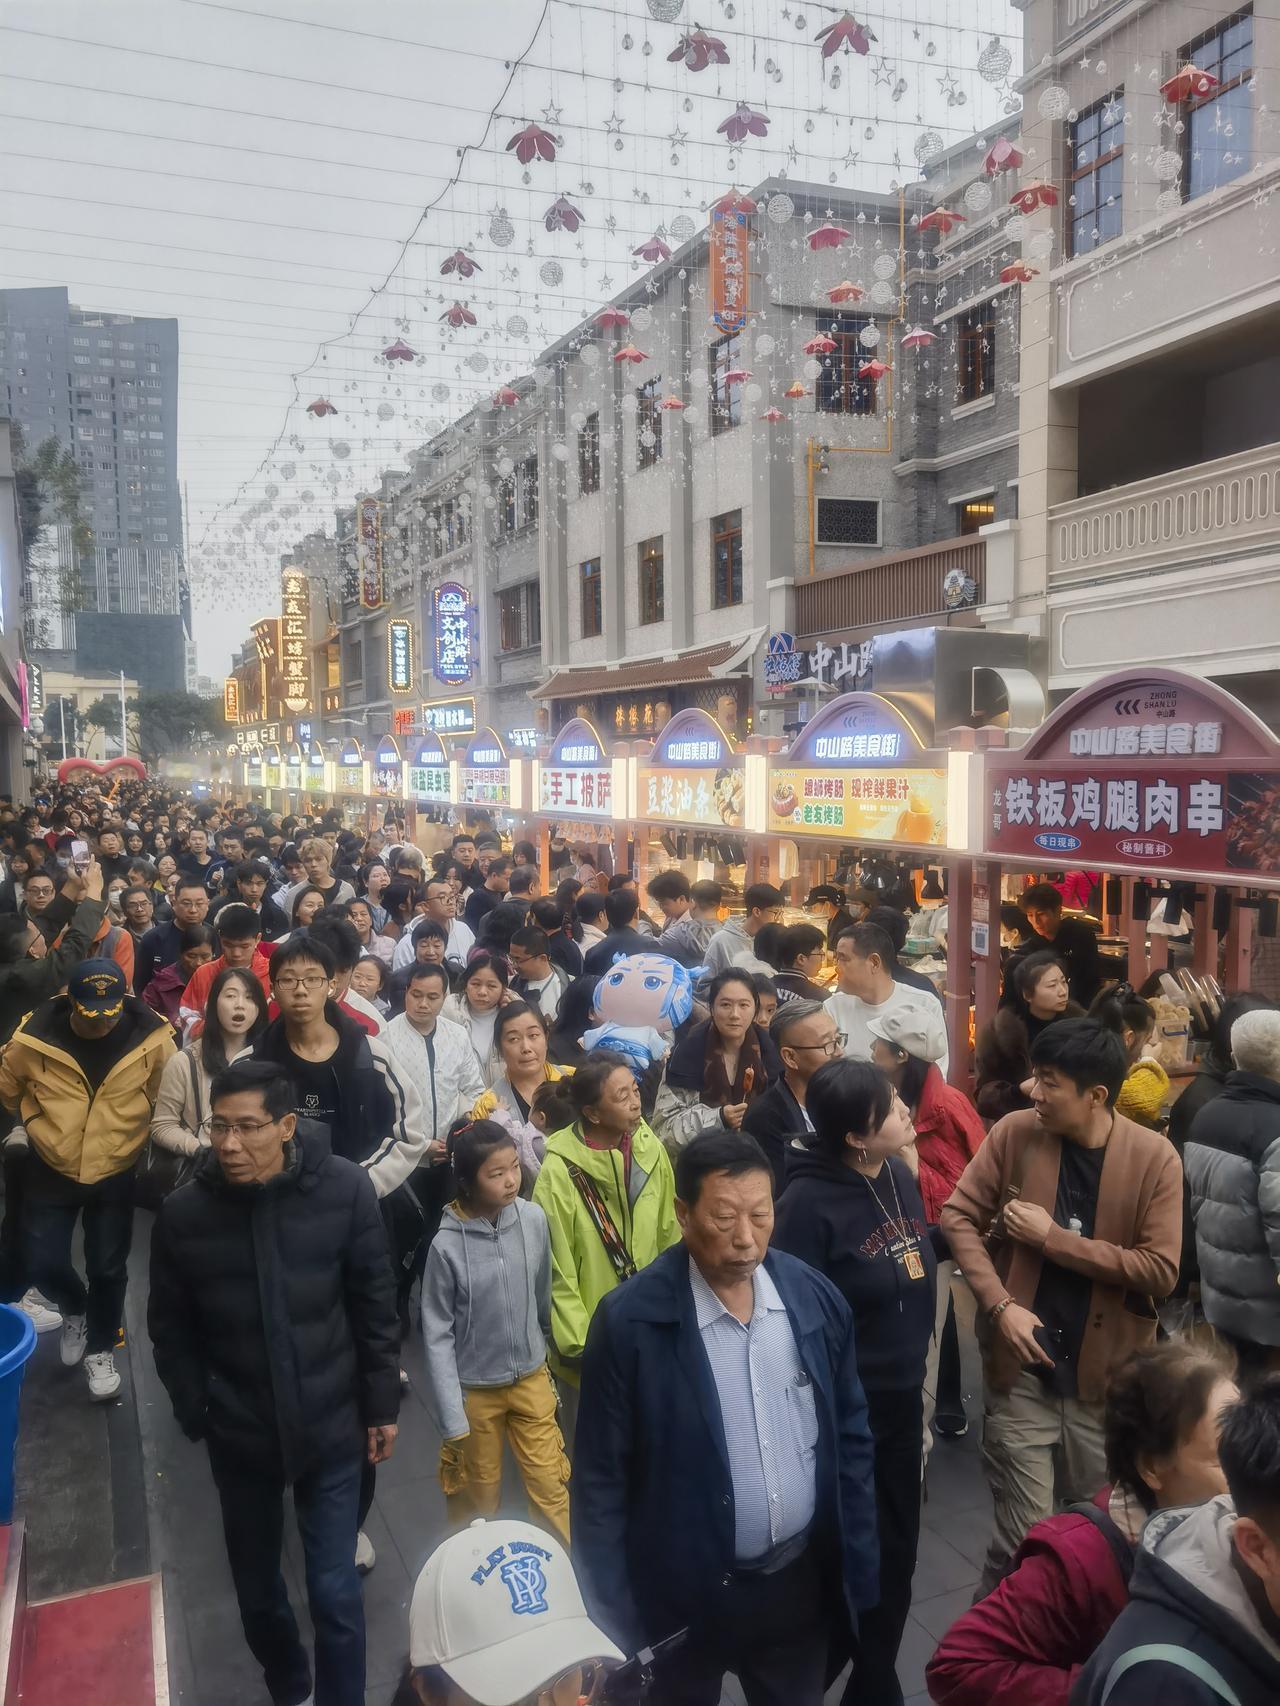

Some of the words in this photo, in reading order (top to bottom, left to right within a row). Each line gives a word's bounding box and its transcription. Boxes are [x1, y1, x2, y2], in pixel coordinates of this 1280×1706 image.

[1150, 690, 1177, 700] ZHONG
[1156, 709, 1176, 719] 中山路
[815, 733, 901, 758] 中山路美食街
[1069, 722, 1223, 756] 中山路美食街
[551, 772, 611, 809] 手工披萨
[646, 774, 710, 818] 豆浆油条
[851, 777, 910, 800] 现榨鲜果汁
[803, 804, 844, 826] 老友烤肠
[992, 789, 1002, 831] 龙哥
[1005, 776, 1224, 837] 铁板鸡腿肉串
[1039, 835, 1076, 849] 每日现串
[1122, 841, 1167, 856] 秘制酱料
[471, 1546, 507, 1586] PLAY
